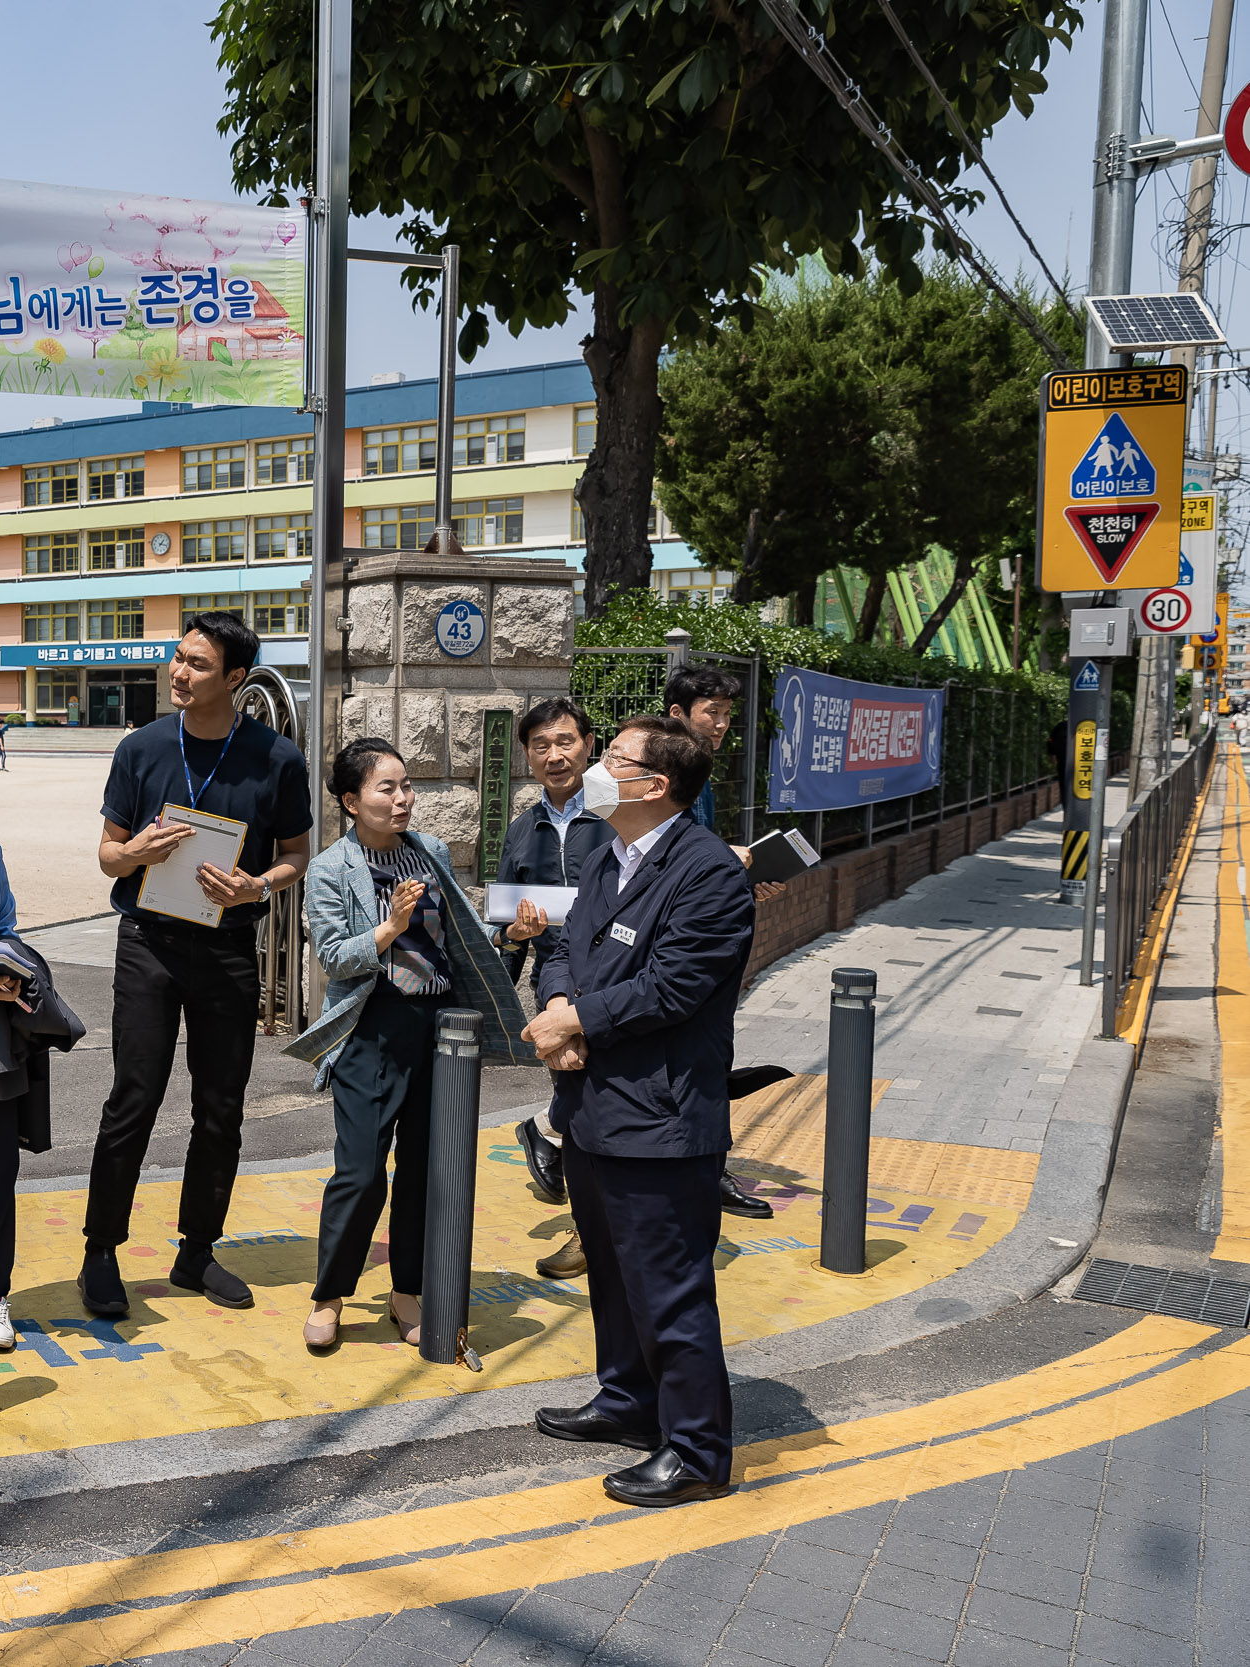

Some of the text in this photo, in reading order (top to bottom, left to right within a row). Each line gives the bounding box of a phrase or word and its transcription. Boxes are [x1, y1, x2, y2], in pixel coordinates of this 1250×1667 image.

[137, 266, 256, 326] 존경을
[1053, 372, 1181, 404] 어린이보호구역
[1075, 478, 1150, 495] 어린이보호
[1087, 515, 1137, 533] 천천히
[1096, 533, 1126, 544] SLOW
[1151, 598, 1181, 623] 30
[447, 622, 472, 640] 43
[37, 645, 166, 662] 바르고 슬기롭고 아름답게
[848, 708, 892, 762] 반려동물
[810, 735, 844, 773] 보도블럭
[484, 717, 507, 875] 서울중마초등학교
